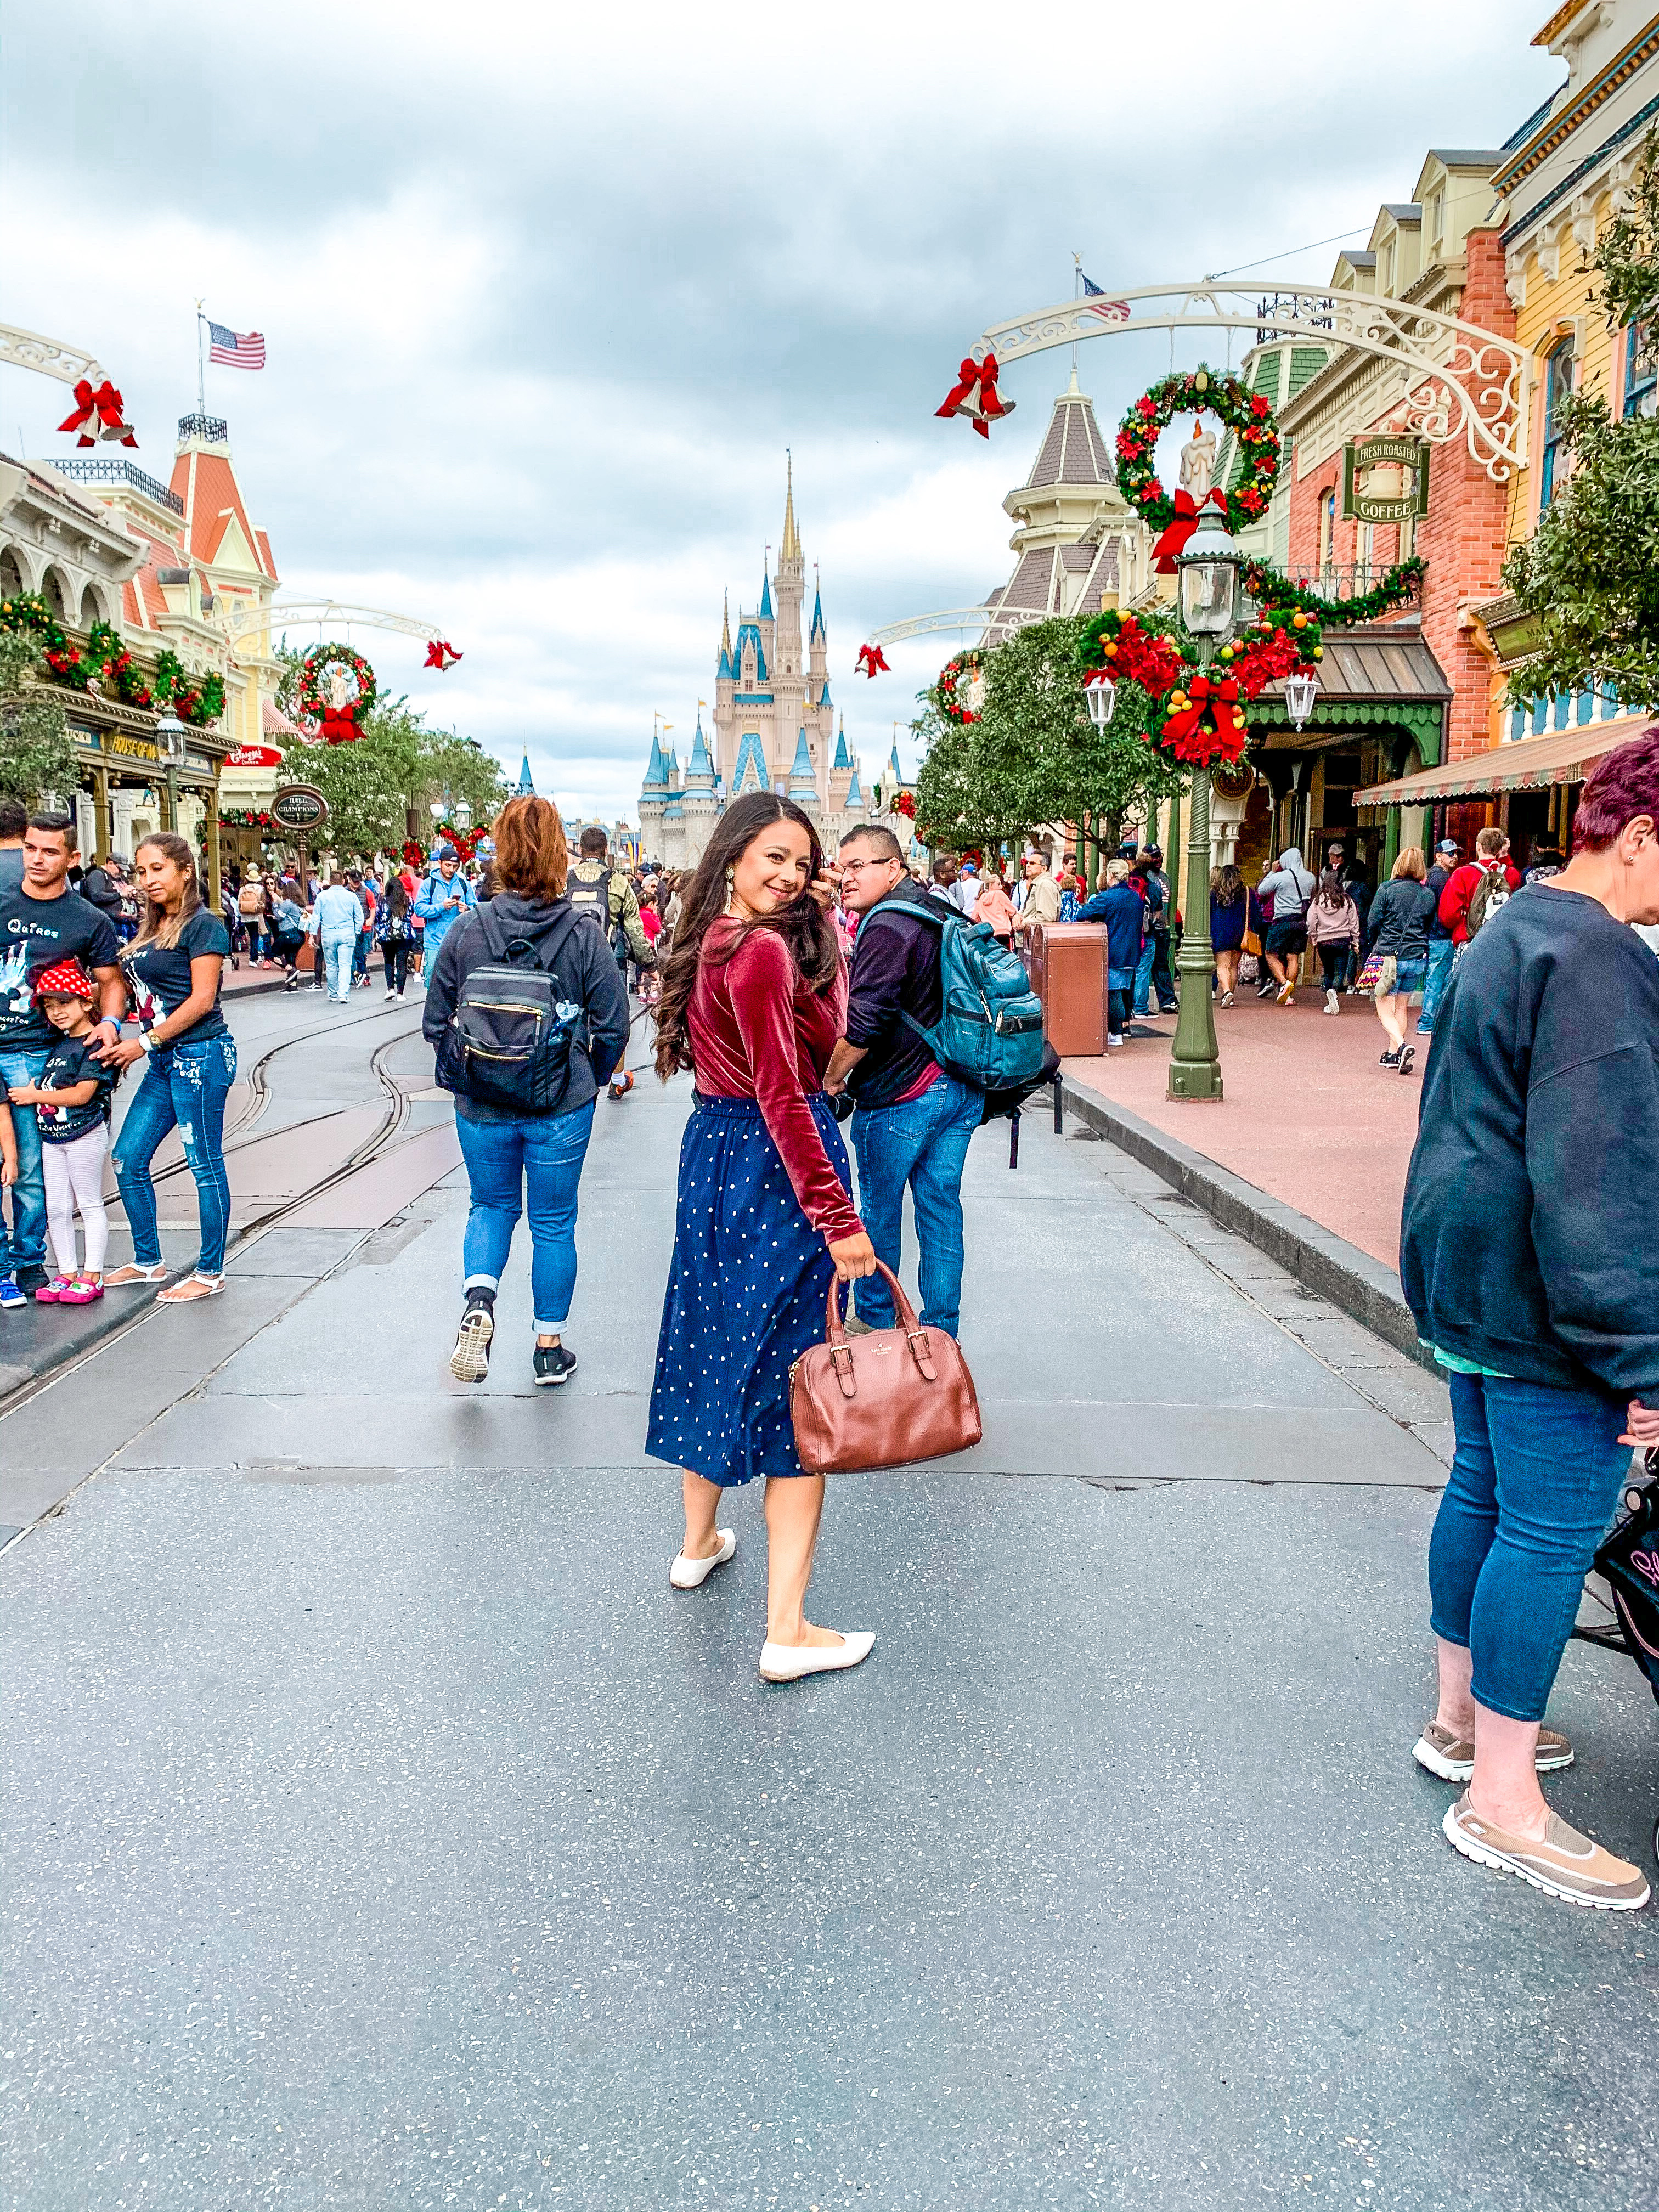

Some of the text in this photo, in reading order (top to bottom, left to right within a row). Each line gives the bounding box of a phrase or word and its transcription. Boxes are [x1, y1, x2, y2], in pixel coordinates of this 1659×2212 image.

[1360, 444, 1415, 461] FRESH ROASTED
[1360, 501, 1411, 518] COFFEE
[111, 736, 137, 756] HOUSE
